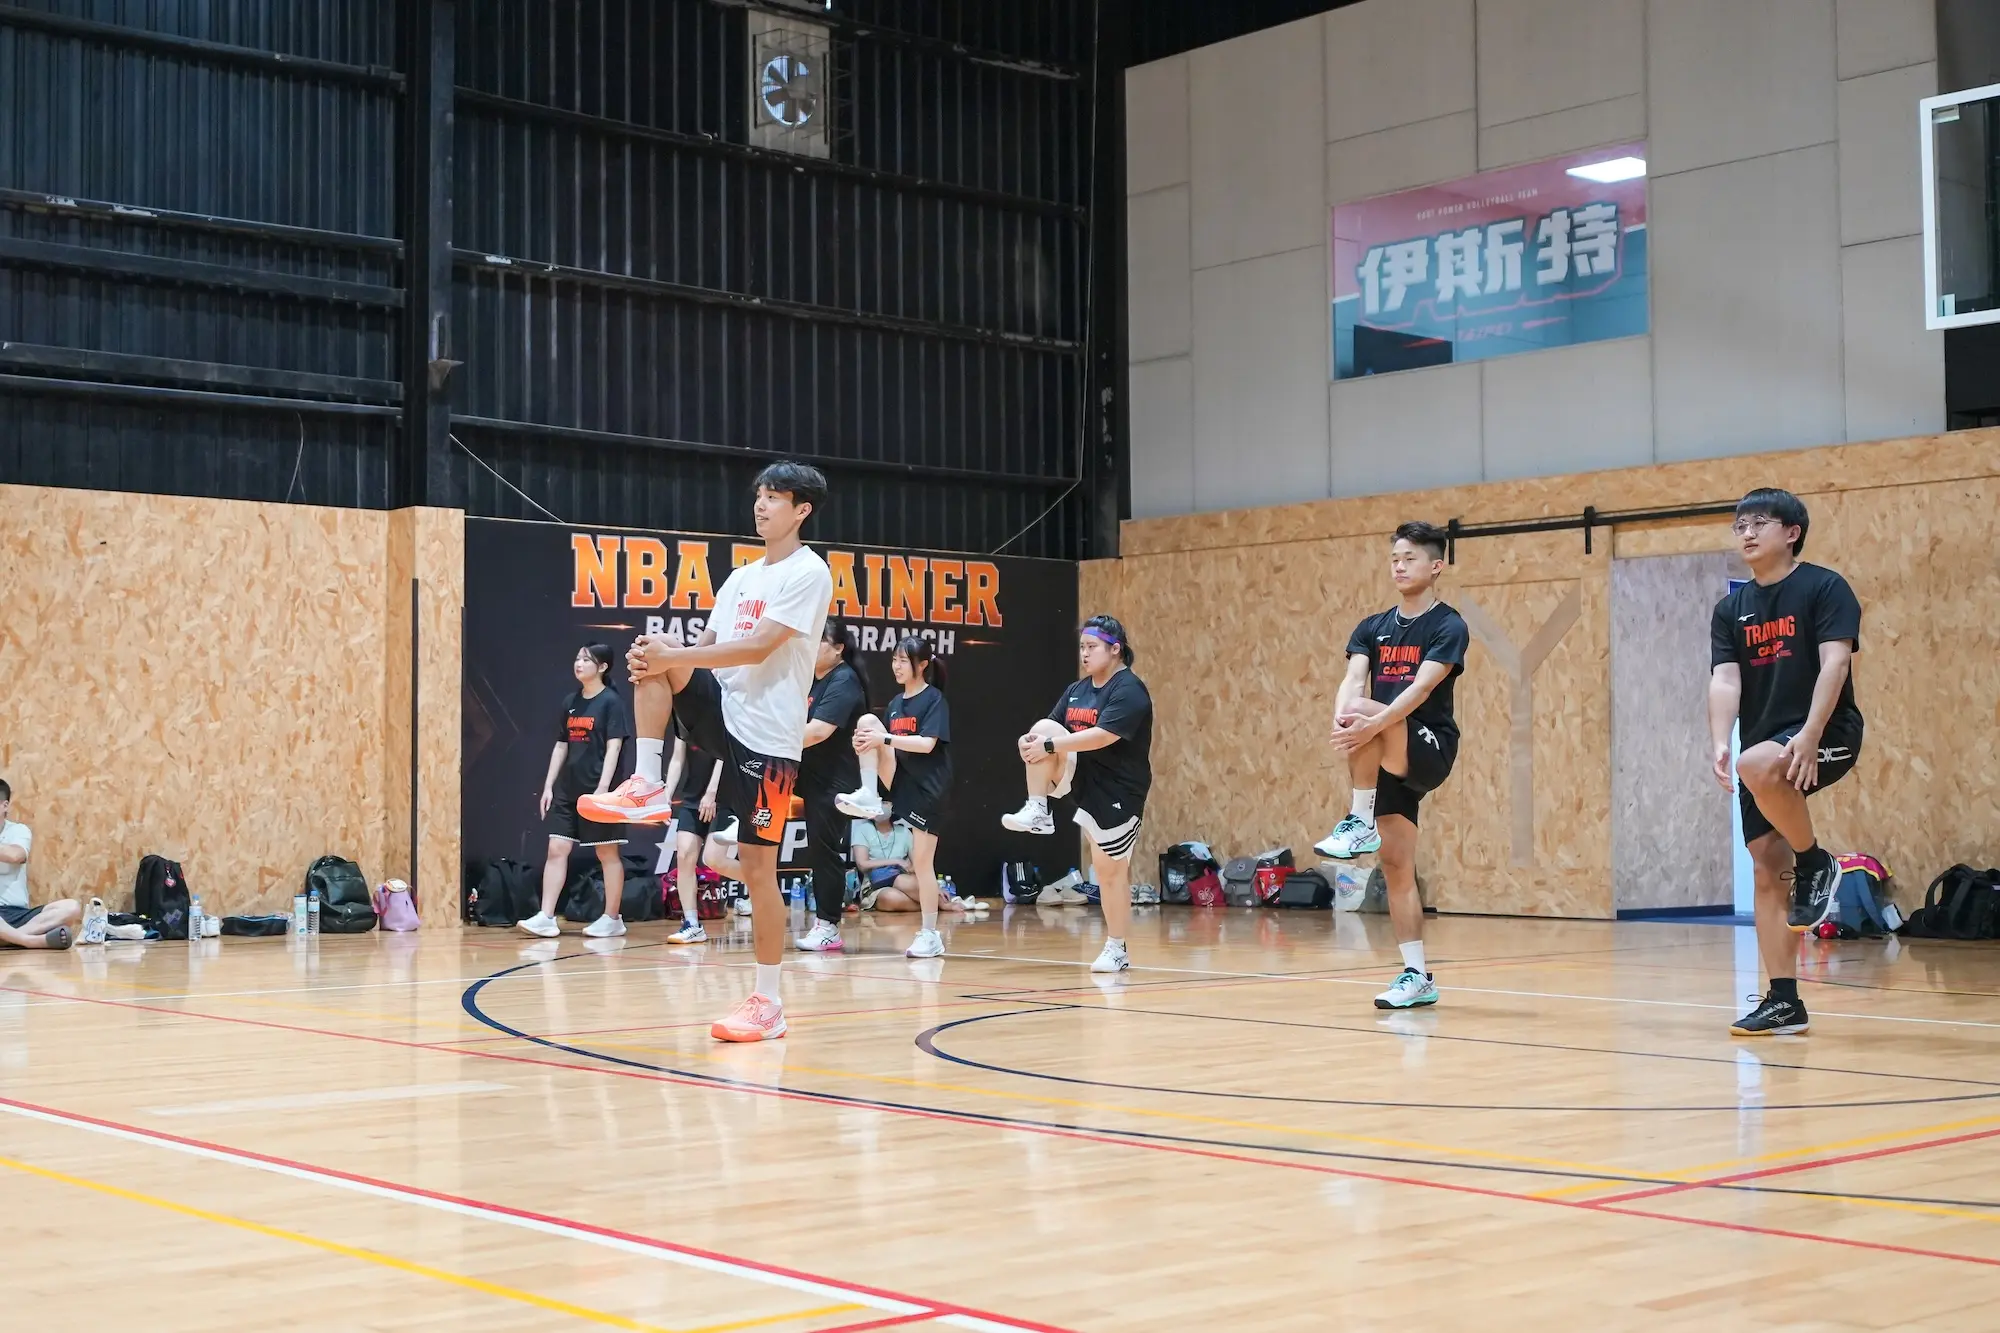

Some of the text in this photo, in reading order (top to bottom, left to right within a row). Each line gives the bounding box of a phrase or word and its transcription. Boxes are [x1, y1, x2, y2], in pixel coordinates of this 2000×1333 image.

[1467, 193, 1515, 210] VOLLEYBALL
[1518, 187, 1539, 199] TEAM
[1358, 203, 1618, 316] 伊斯特
[571, 532, 717, 610] NBA
